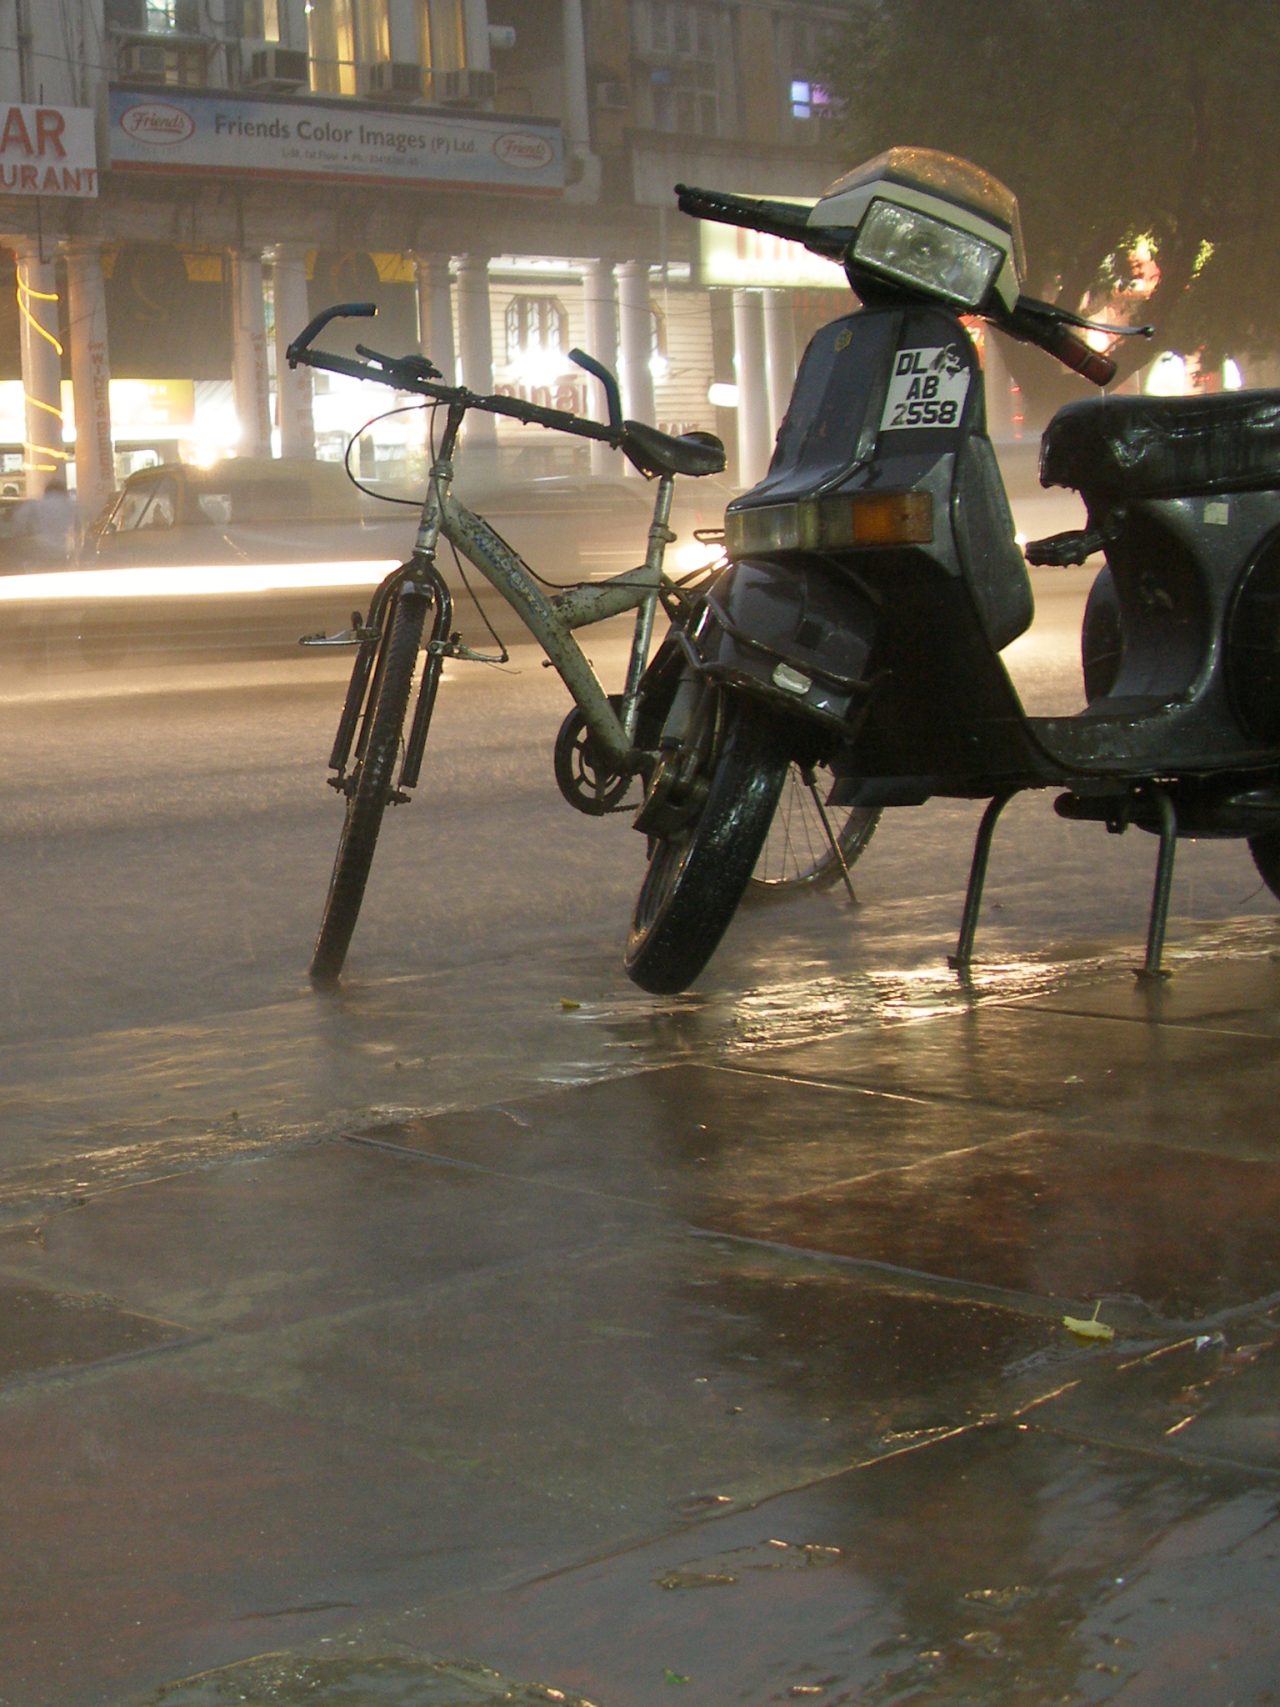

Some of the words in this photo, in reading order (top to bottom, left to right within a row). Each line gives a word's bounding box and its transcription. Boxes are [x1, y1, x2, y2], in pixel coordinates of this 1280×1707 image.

[131, 112, 185, 132] Friends
[214, 113, 290, 139] Friends
[296, 120, 354, 143] Color
[359, 125, 426, 152] Images
[431, 136, 450, 154] (P)
[896, 352, 928, 376] DL
[906, 375, 940, 400] AB
[890, 400, 958, 426] 2558
